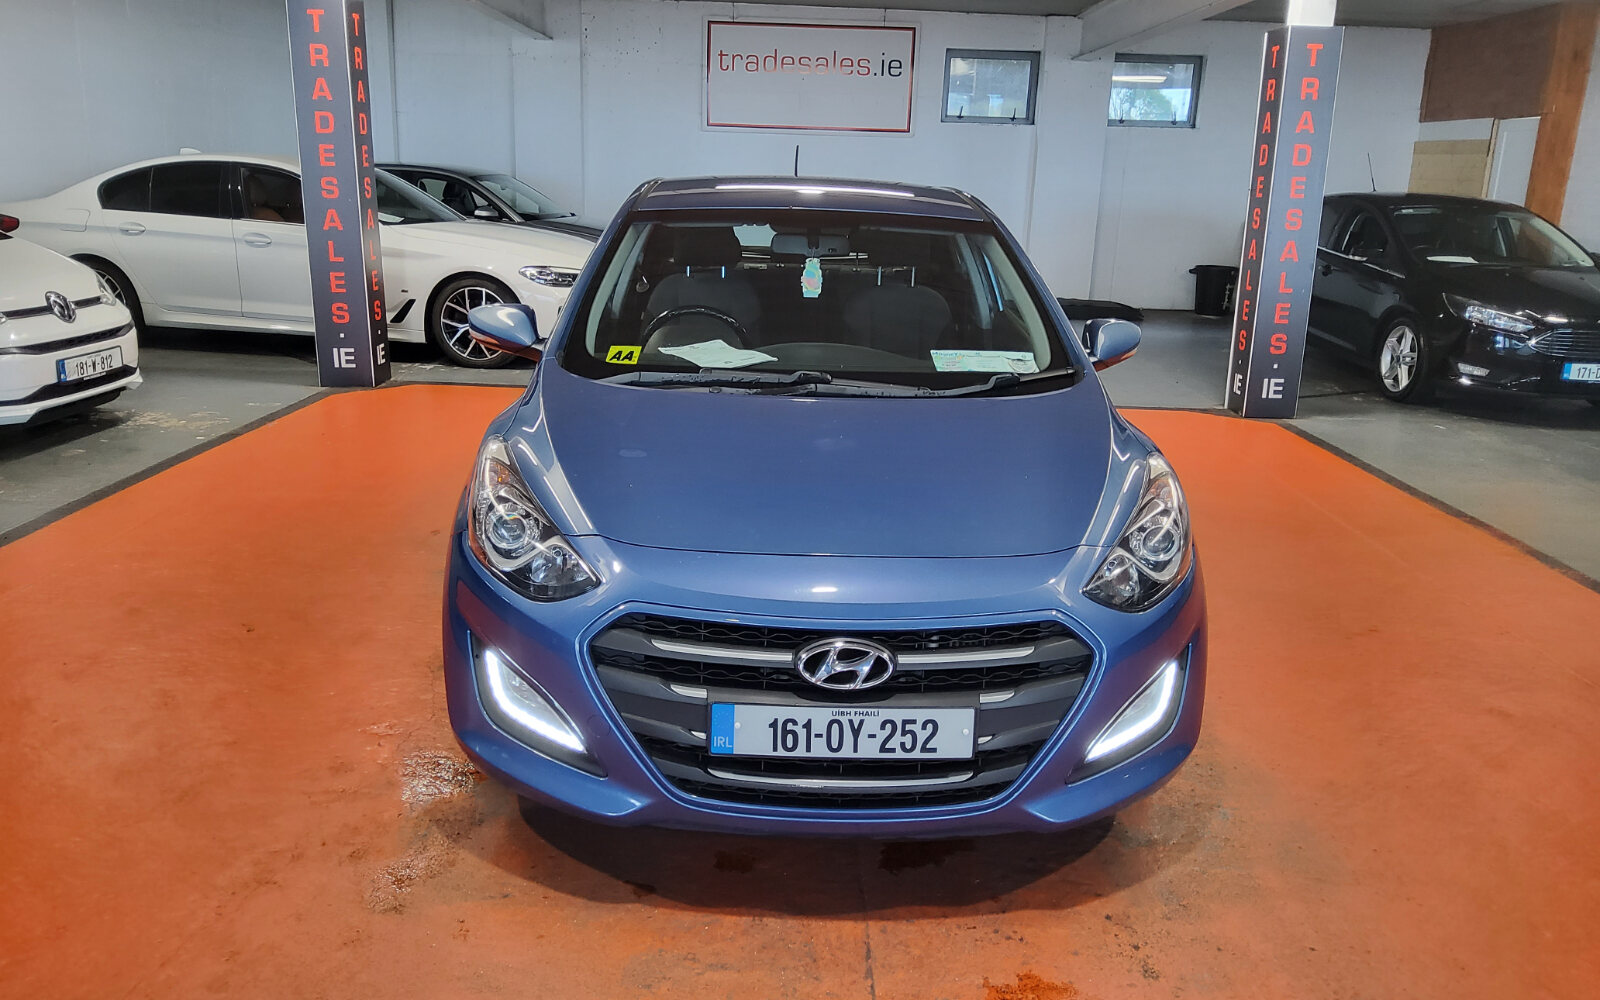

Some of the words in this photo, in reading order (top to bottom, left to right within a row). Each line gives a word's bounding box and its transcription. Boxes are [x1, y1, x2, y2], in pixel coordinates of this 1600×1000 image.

[717, 48, 903, 77] tradesales.ie
[306, 9, 357, 369] TRADESALES.IE
[1261, 43, 1324, 399] TRADESALES.IE
[75, 354, 113, 376] 181-W-812
[608, 350, 635, 362] AA
[713, 735, 733, 748] IRL
[768, 717, 940, 754] 161-OY-252
